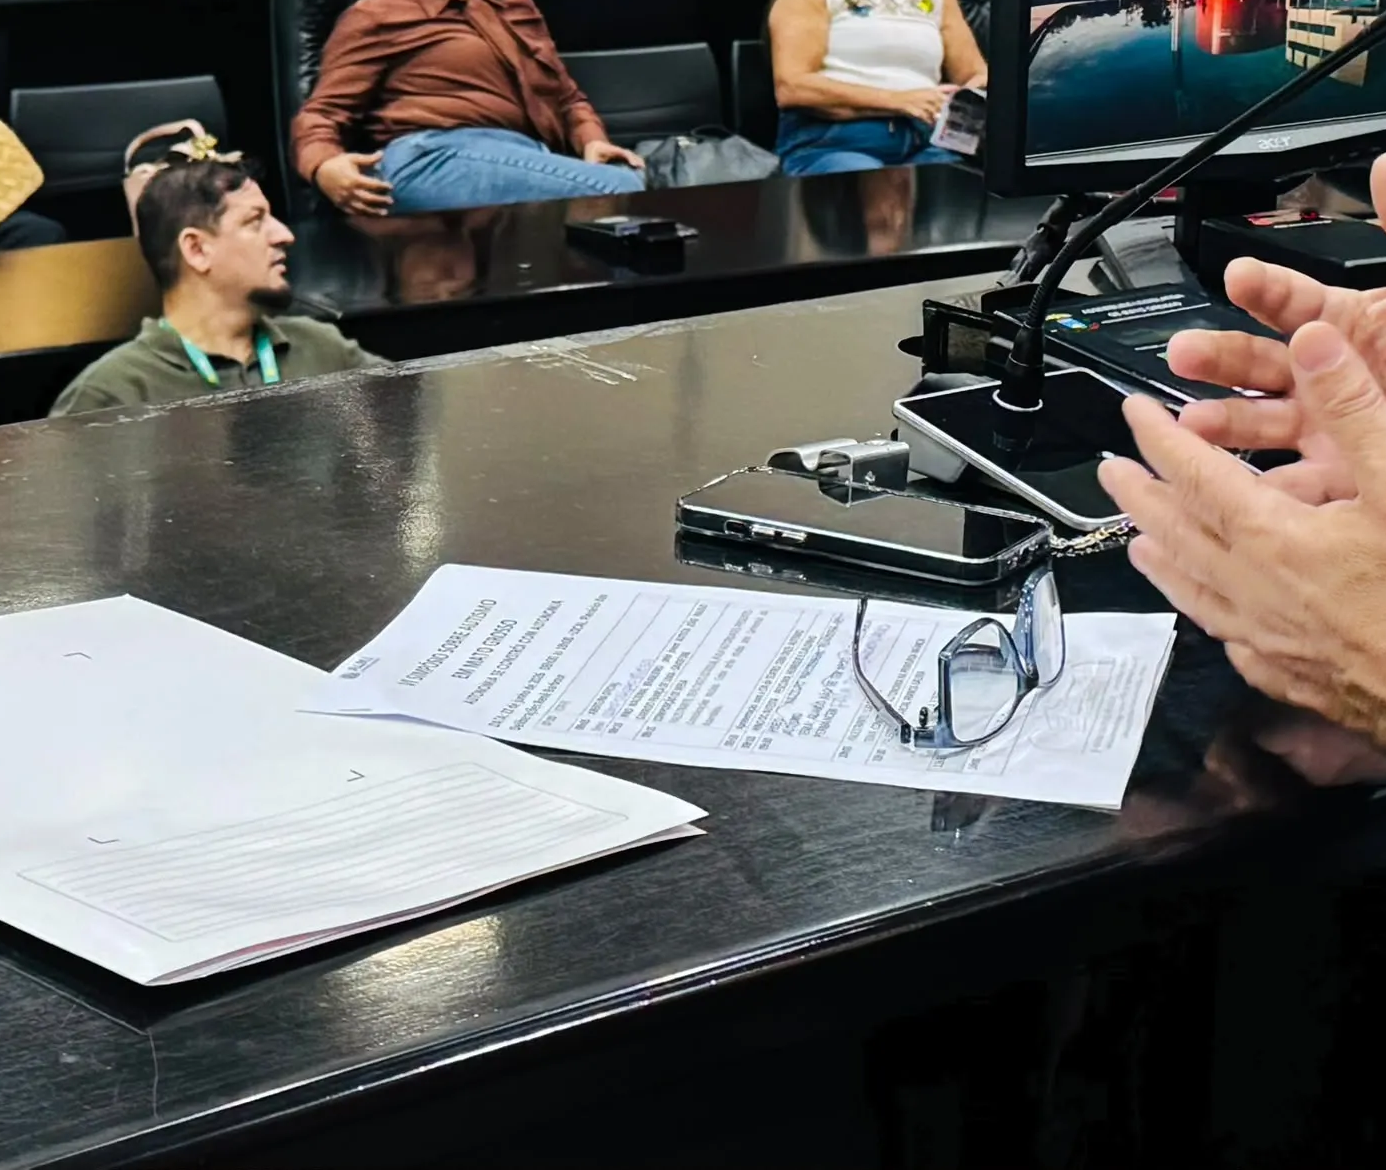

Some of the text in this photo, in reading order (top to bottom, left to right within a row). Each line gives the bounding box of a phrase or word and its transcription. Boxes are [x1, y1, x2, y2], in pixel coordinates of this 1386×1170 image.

[1257, 136, 1291, 150] acer
[405, 652, 450, 681] SIMPÓSIO
[437, 631, 470, 653] SOBRE
[458, 599, 497, 630] AUTISMO
[451, 619, 518, 679] EM MATO GROSSO
